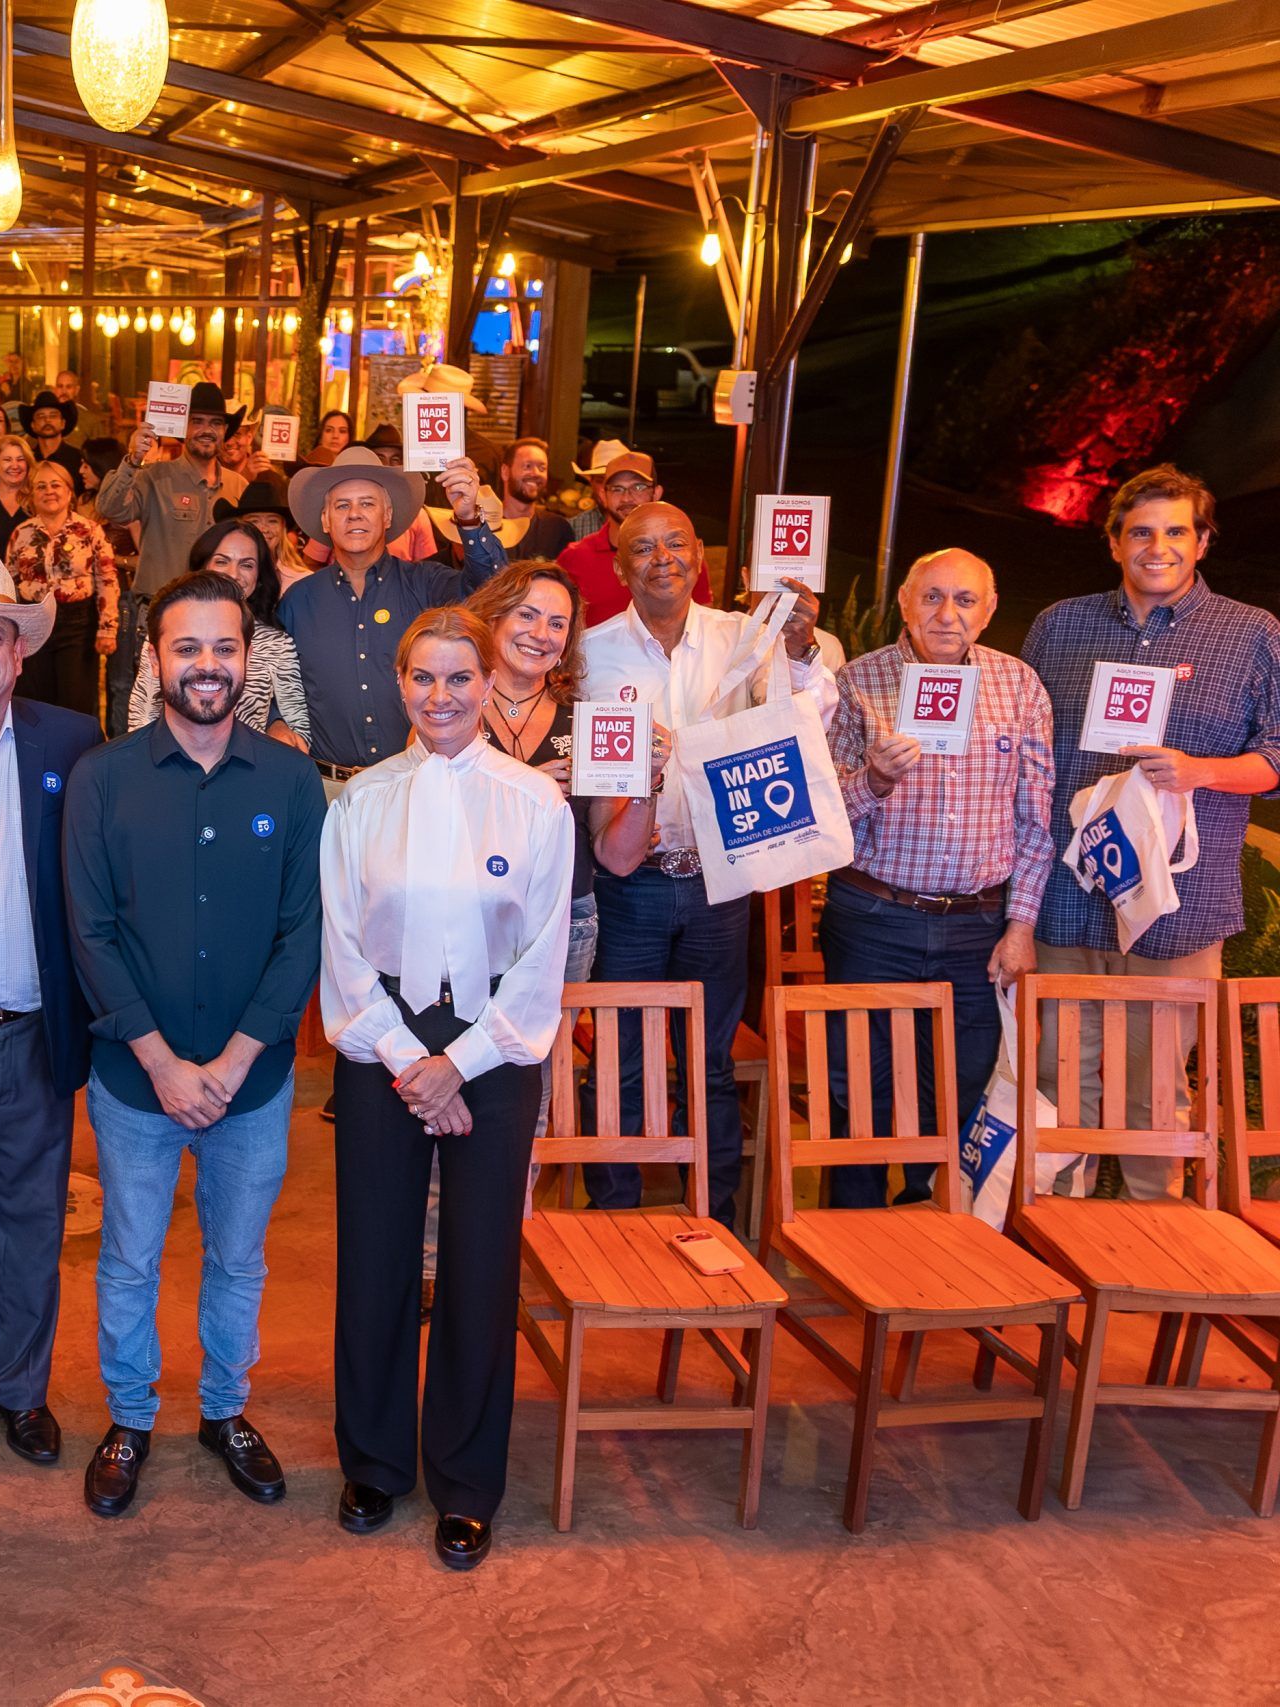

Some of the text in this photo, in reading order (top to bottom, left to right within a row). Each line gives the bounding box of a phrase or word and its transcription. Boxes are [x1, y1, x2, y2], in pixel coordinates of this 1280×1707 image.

[420, 408, 448, 418] MADE
[420, 418, 430, 428] IN
[420, 429, 432, 439] SP
[775, 514, 810, 527] MADE
[775, 527, 787, 539] IN
[773, 541, 788, 552] SP
[921, 682, 959, 694] MADE
[1112, 681, 1152, 696] MADE
[919, 693, 933, 705] IN
[1110, 694, 1124, 705] IN
[917, 706, 933, 717] SP
[1107, 706, 1124, 717] SP
[594, 721, 632, 732] MADE
[594, 733, 608, 745] IN
[593, 747, 609, 758] SP
[733, 748, 765, 762] PRODUTOS
[764, 739, 795, 753] PAULISTAS
[720, 752, 790, 789] MADE
[727, 787, 752, 811] IN
[732, 810, 760, 834] SP
[727, 832, 763, 846] GARANTIA
[762, 828, 773, 837] DE
[772, 815, 812, 833] QUALIDADE
